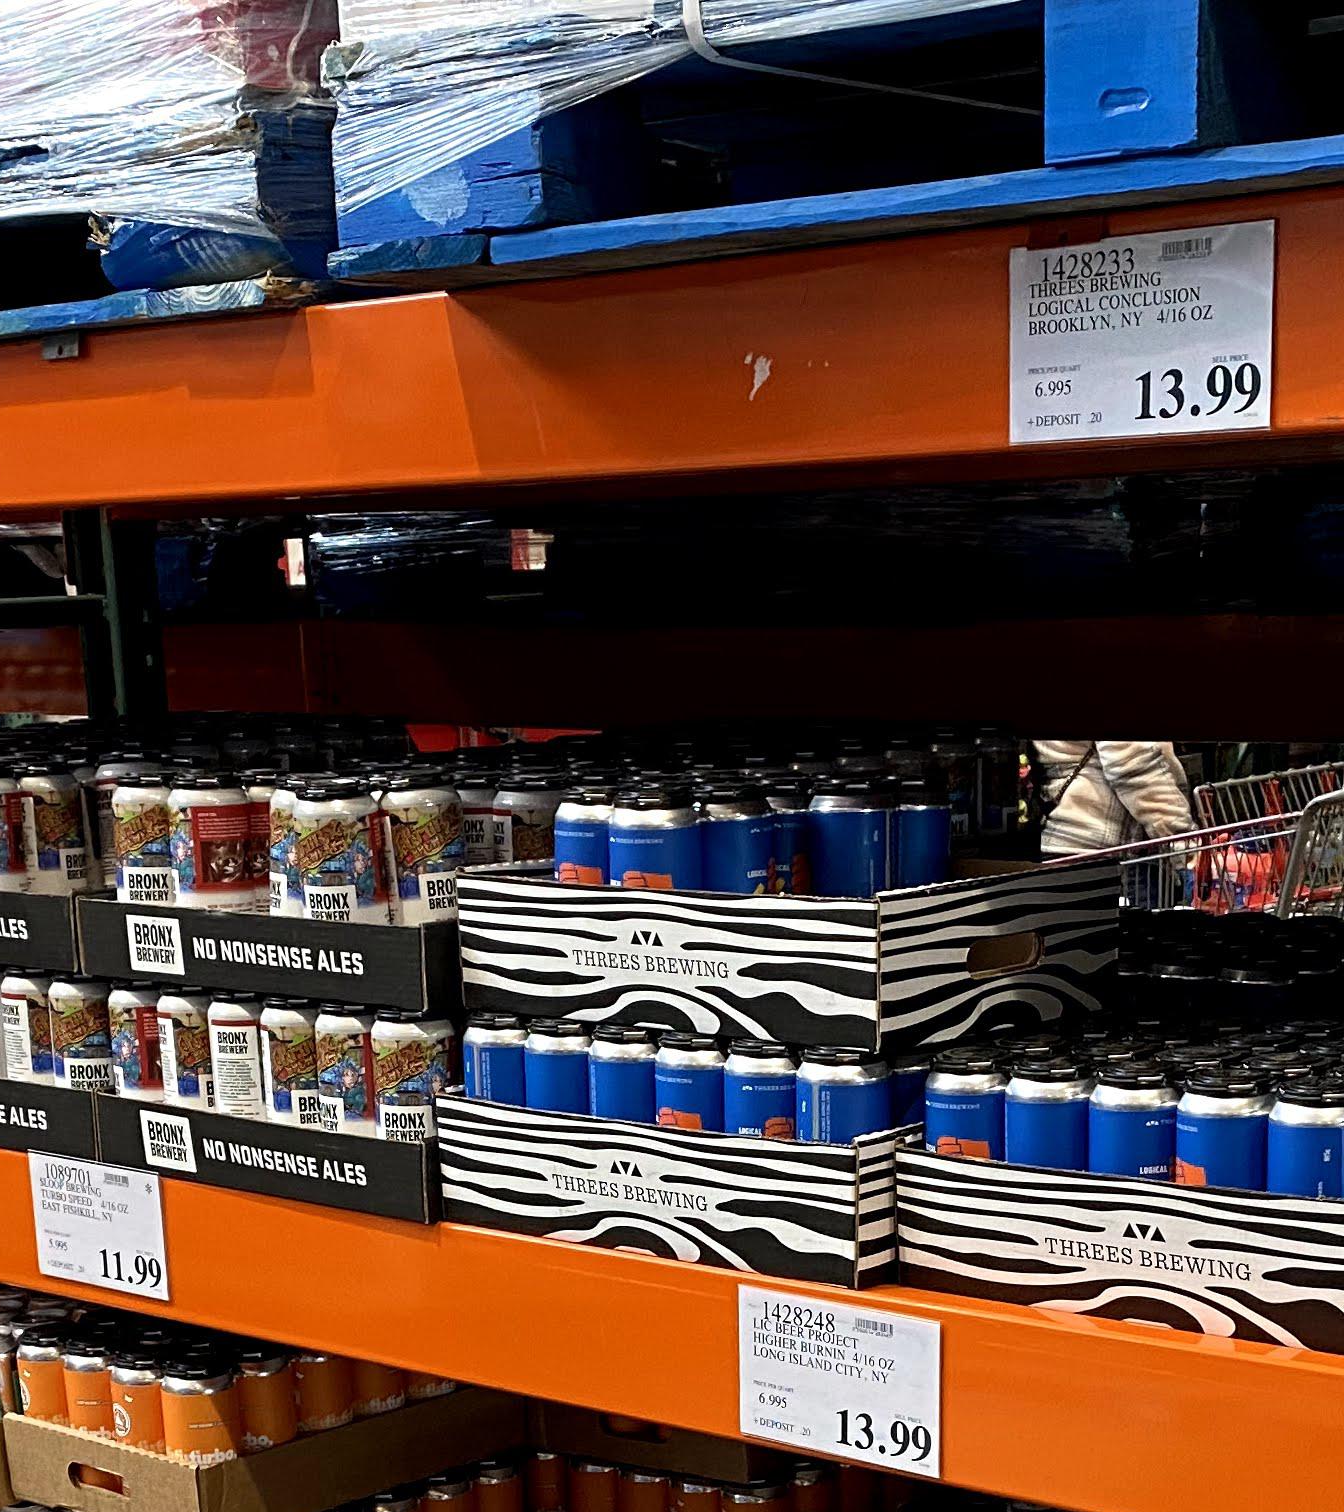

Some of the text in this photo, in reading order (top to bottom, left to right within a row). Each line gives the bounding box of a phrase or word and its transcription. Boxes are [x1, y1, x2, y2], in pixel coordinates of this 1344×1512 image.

[1041, 247, 1135, 282] 1428233
[1029, 272, 1162, 298] THREES BREWING
[1029, 287, 1200, 317] LOGICAL CONCLUSION
[1029, 305, 1213, 335] BROOKLYN, NY 4/16 OZ
[1035, 380, 1072, 397] 6.995
[1135, 362, 1261, 420] 13.99
[128, 873, 169, 890] BRONX
[309, 892, 349, 908] BRONX
[134, 923, 174, 948] BRONX
[136, 947, 176, 965] BREWERY
[193, 936, 363, 975] NO NONSENSE ALES
[571, 948, 729, 980] THREES BREWING
[217, 1031, 248, 1044] BRONX
[9, 1106, 47, 1130] ALES
[384, 1112, 425, 1128] BRONX
[148, 1121, 185, 1145] BRONX
[151, 1143, 188, 1162] BREWERY
[203, 1138, 367, 1186] NO NONSENSE ALES
[40, 1177, 101, 1198] SLOOP BREWING
[45, 1163, 92, 1186] 1089701
[41, 1189, 128, 1214] TURBO SPEED 4/16 OZ
[551, 1172, 709, 1213] THREES BREWING
[42, 1200, 112, 1221] EAST NY
[99, 1249, 161, 1288] 11.99
[1044, 1236, 1252, 1281] THREES BREWING
[763, 1302, 835, 1332] 1428248
[754, 1317, 859, 1349] LIC BEER PROJECT
[754, 1332, 895, 1371] HIGHER BURNIN 4/16 OZ
[754, 1345, 889, 1384] LONG ISLAND NY
[759, 1392, 787, 1409] 6.995
[836, 1409, 932, 1461] 13.99
